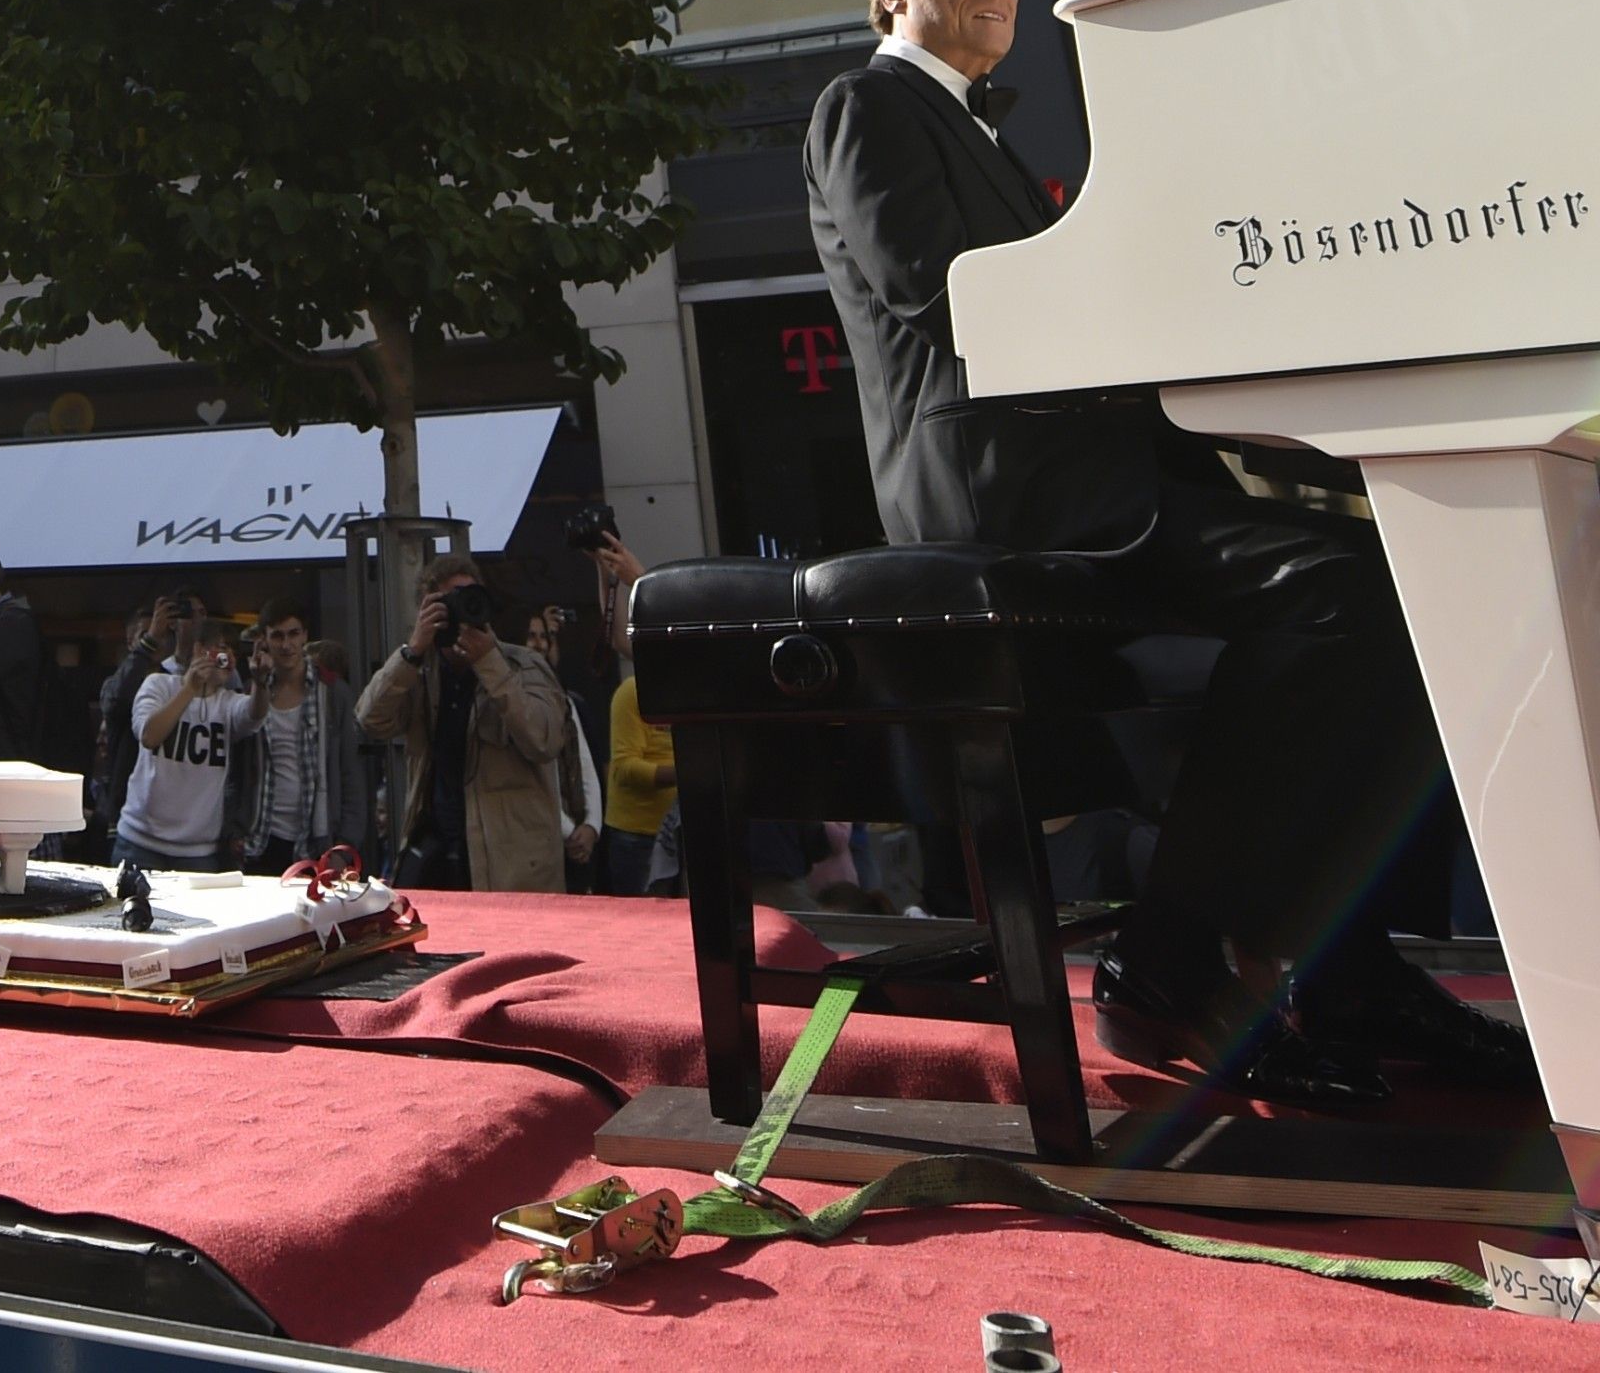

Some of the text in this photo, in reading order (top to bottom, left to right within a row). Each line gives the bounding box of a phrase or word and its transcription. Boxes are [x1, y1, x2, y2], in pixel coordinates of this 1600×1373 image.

[1214, 180, 1589, 287] Bösendorfer
[137, 511, 386, 548] WAGNE
[152, 720, 227, 767] NICE
[1489, 1261, 1577, 1309] 225-581
